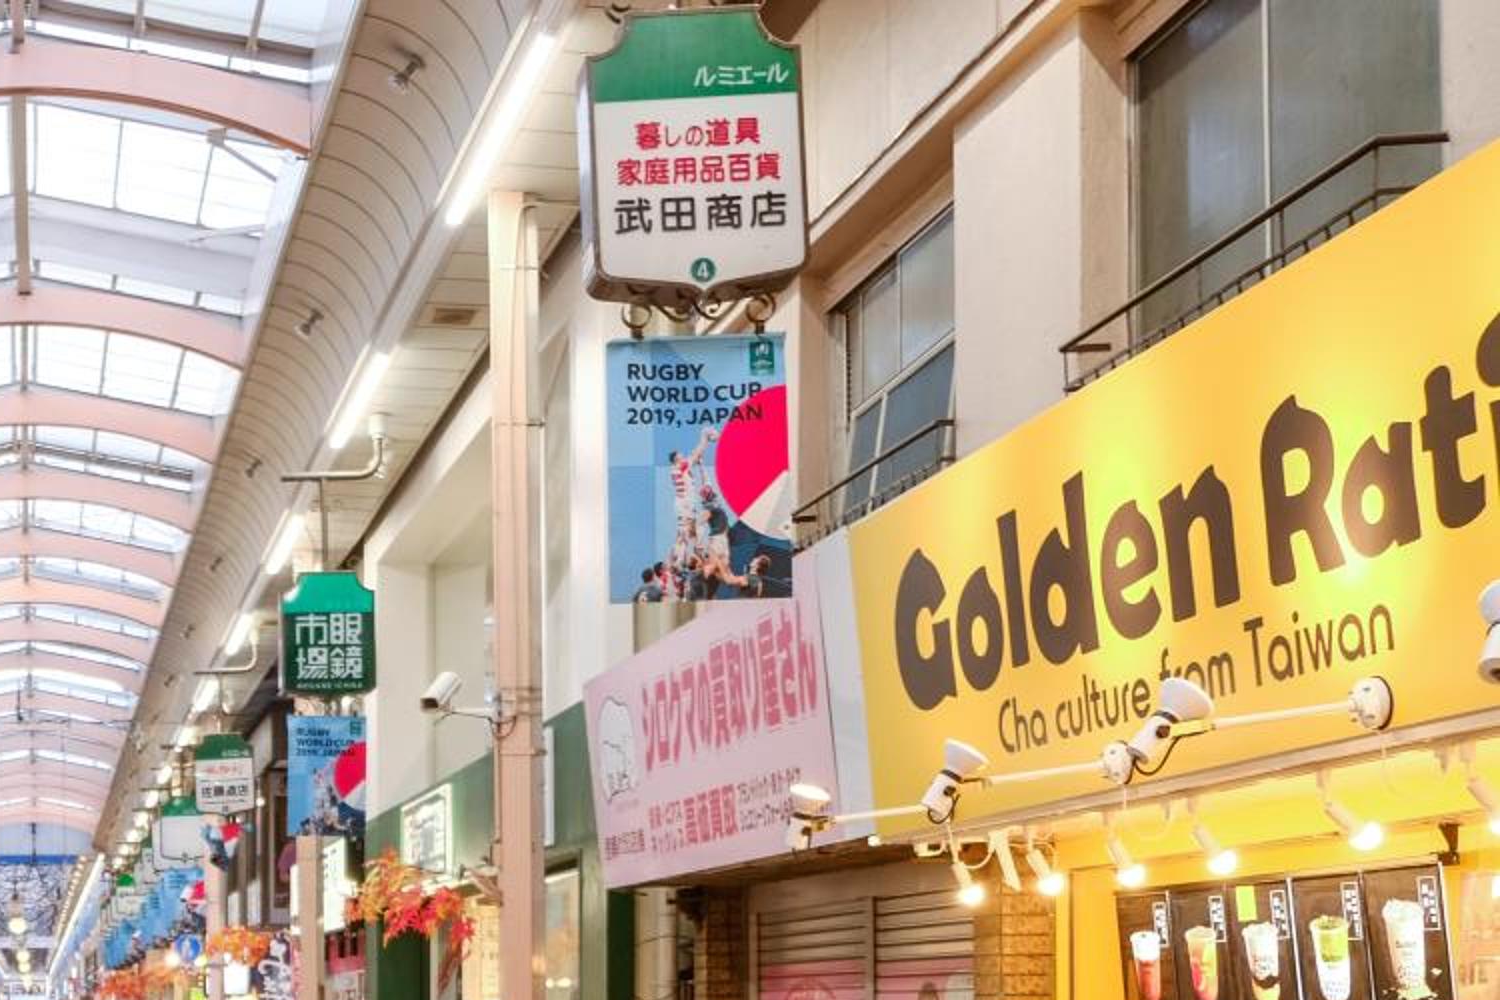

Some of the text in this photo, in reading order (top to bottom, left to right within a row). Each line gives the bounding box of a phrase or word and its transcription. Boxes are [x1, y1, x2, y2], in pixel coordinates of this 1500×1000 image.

[693, 63, 789, 87] ルミエール
[634, 118, 760, 150] 暮しの道具
[617, 153, 780, 186] 家庭用品百貨
[614, 191, 787, 235] 武田商店
[627, 363, 704, 380] RUGBY
[627, 381, 763, 403] WORLD CUP
[627, 404, 764, 428] 2019, JAPAN
[894, 464, 1241, 711] Golden
[642, 607, 818, 771] シロクマの買取り屋さん
[998, 603, 1395, 754] Cha culture fom Taiwan
